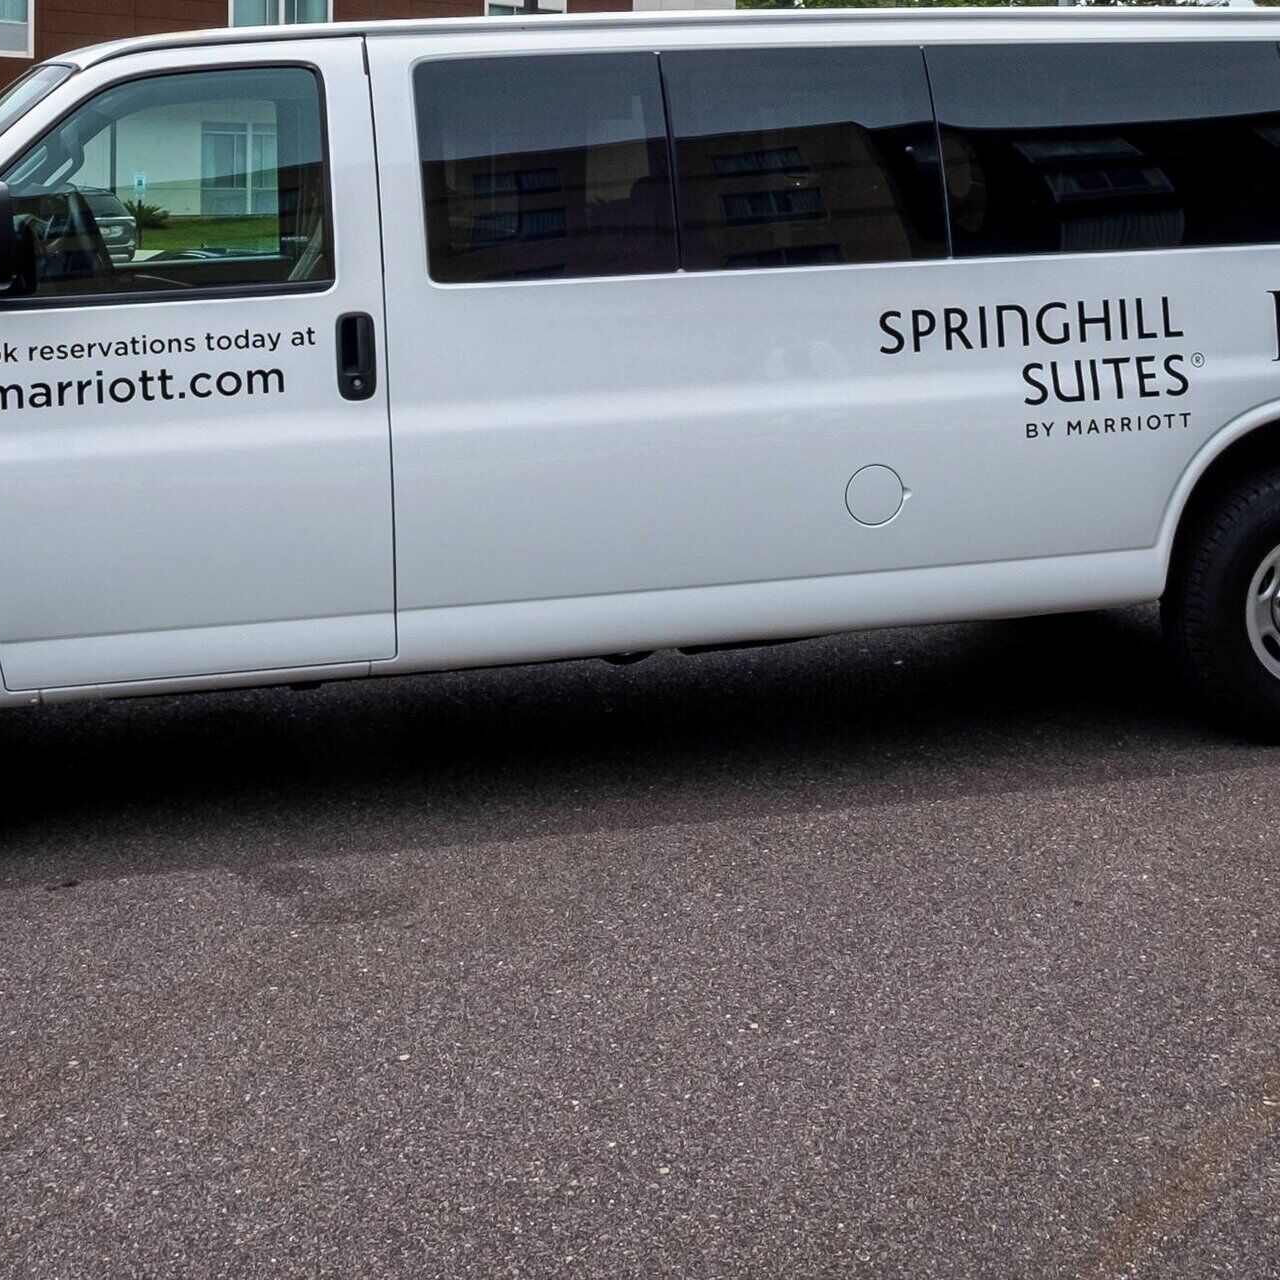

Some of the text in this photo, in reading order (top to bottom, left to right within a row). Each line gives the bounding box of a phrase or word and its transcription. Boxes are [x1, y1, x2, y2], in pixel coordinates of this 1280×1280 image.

[879, 296, 1183, 355] SPRINGHILL
[28, 334, 196, 362] reservations
[204, 326, 282, 352] today
[291, 326, 316, 347] at
[1025, 412, 1192, 439] BY MARRIOTT
